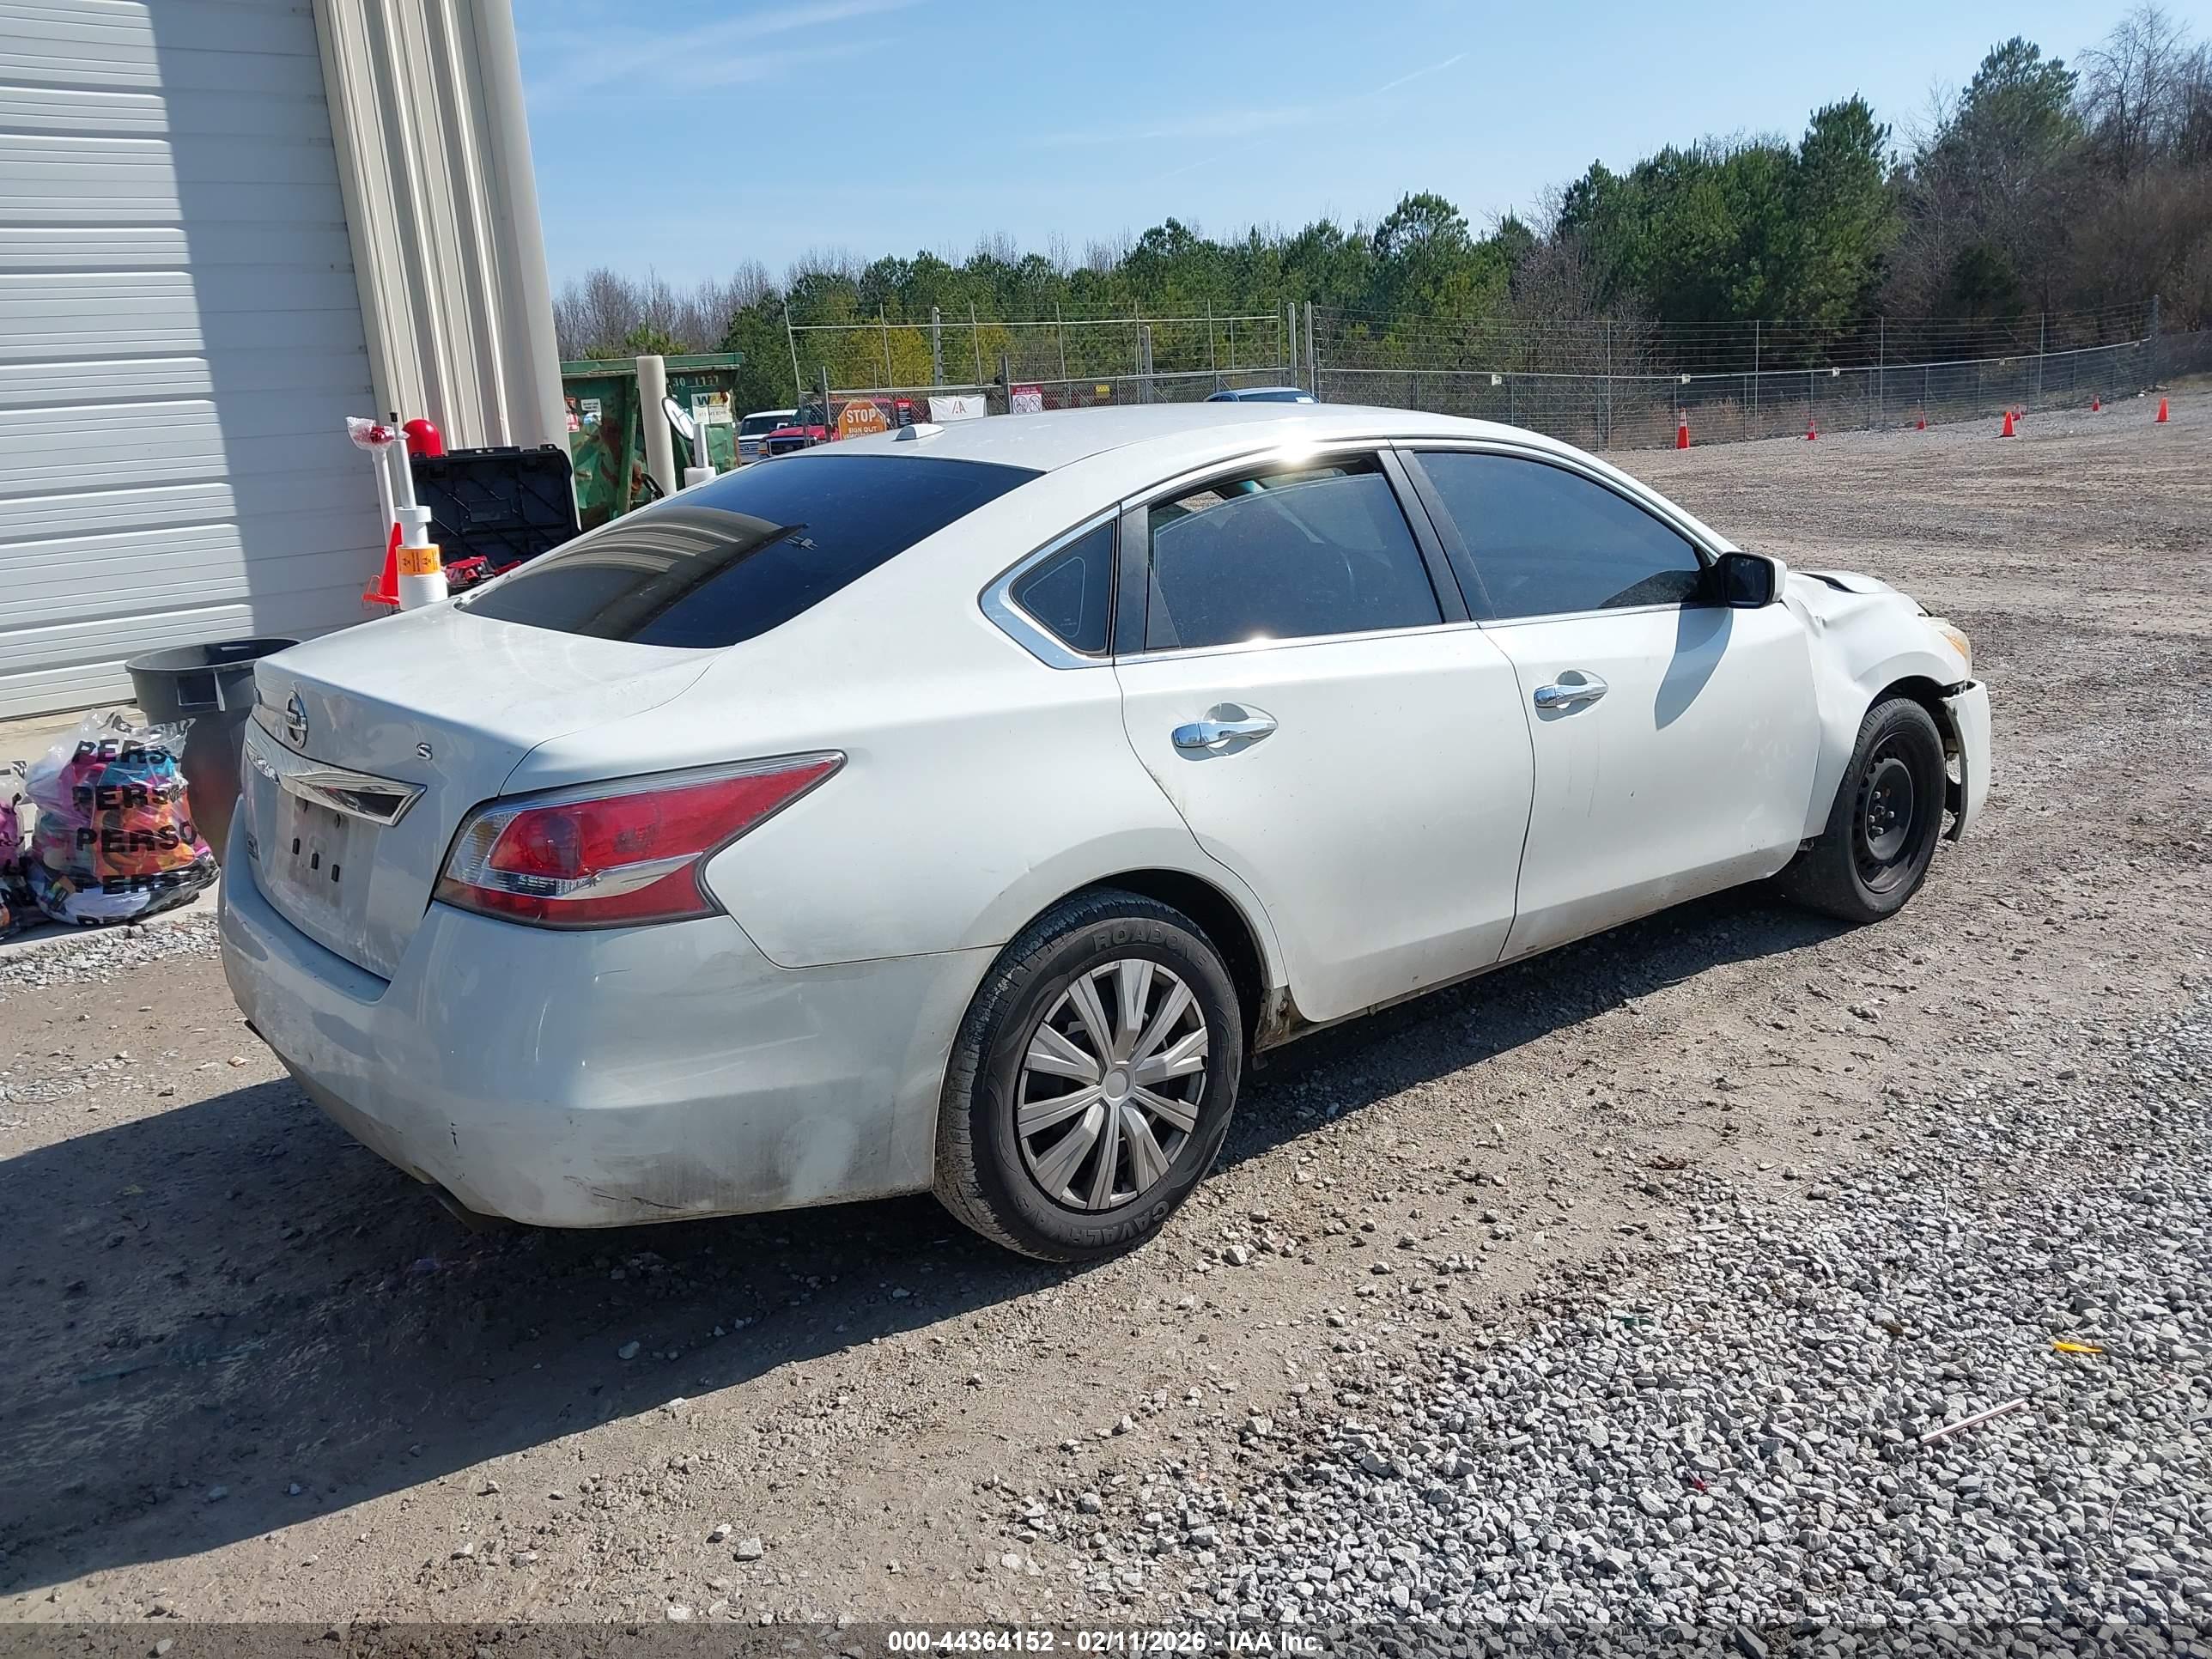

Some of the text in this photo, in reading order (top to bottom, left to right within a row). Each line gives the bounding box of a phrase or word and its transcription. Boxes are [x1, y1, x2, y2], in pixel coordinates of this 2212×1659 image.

[846, 408, 876, 424] STOP
[416, 742, 433, 761] S
[76, 822, 197, 853] PERSO
